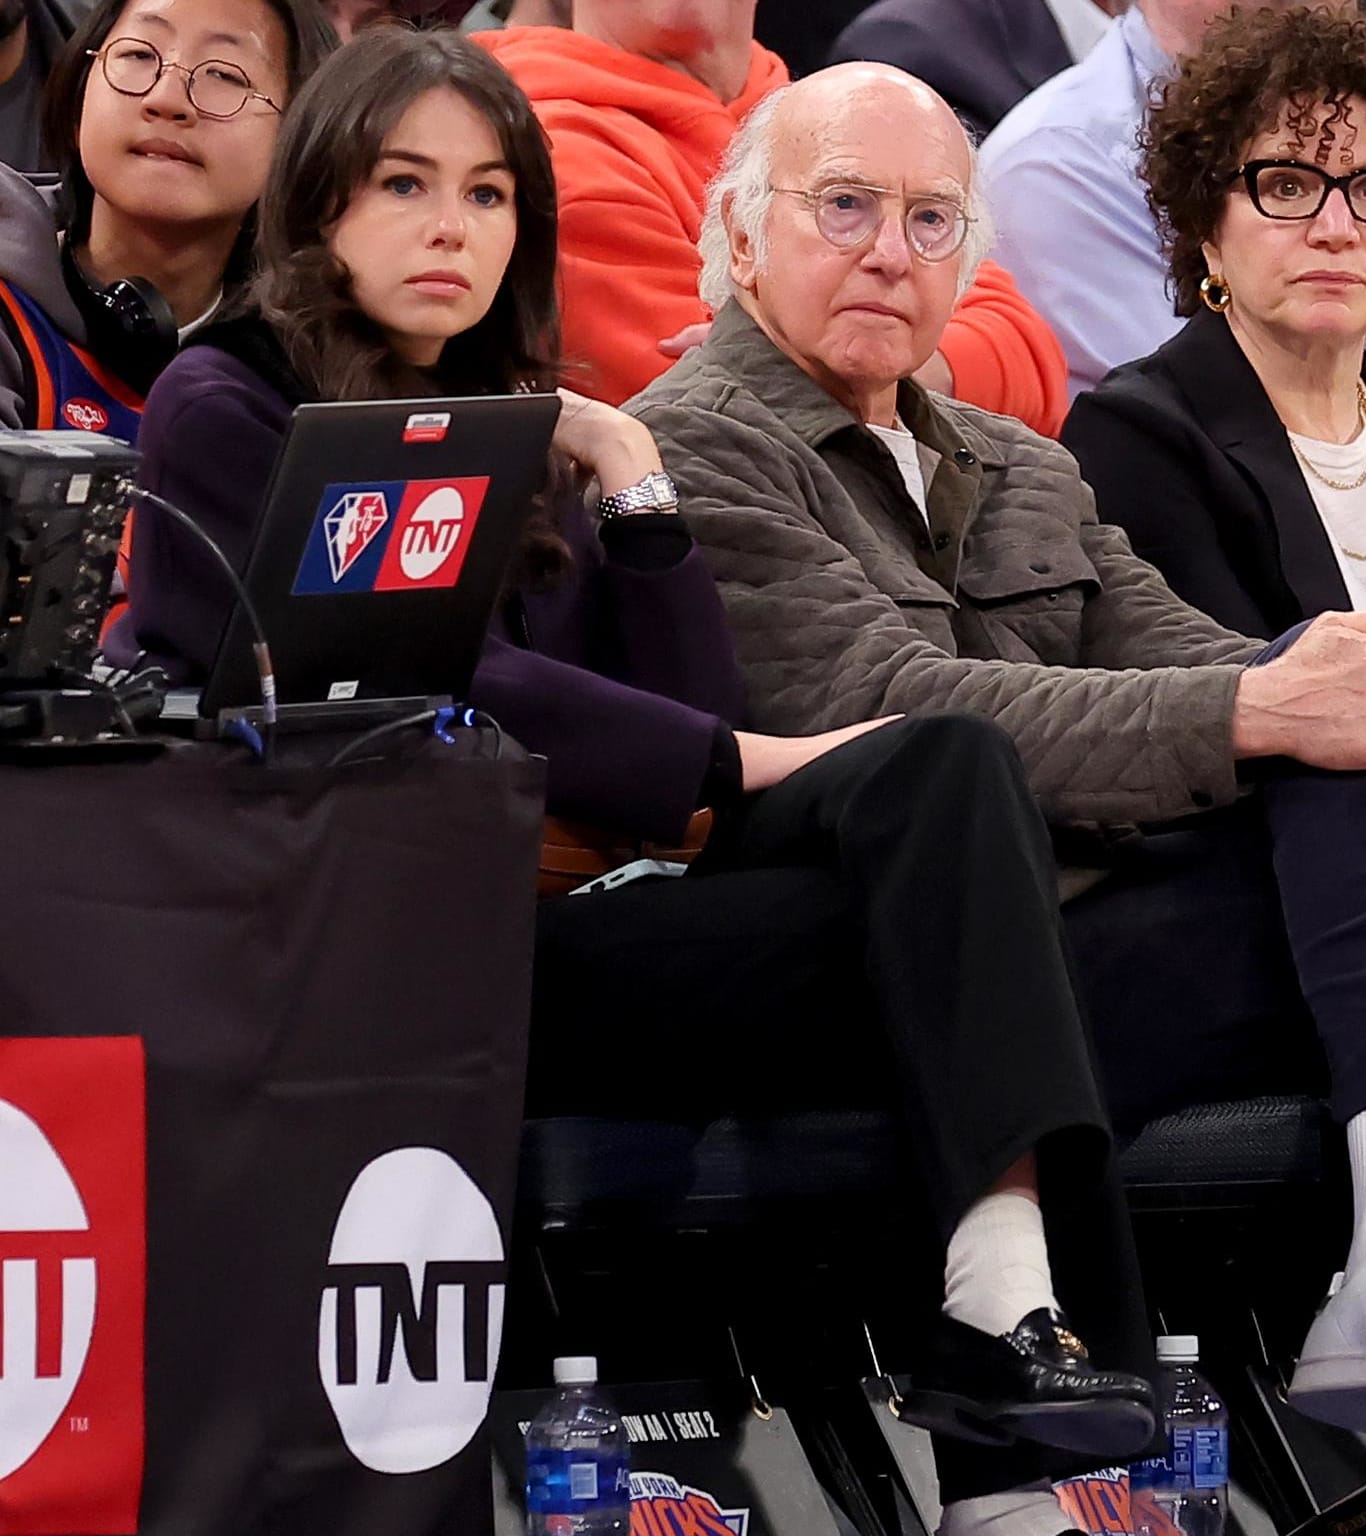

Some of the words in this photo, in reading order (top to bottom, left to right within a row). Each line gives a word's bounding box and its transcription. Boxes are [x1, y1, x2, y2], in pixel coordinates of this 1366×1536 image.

[322, 1260, 506, 1386] TNT
[70, 1417, 88, 1432] TM
[621, 1415, 649, 1442] OW
[643, 1414, 668, 1441] AA
[673, 1412, 709, 1439] SEAT
[702, 1411, 720, 1437] 2
[641, 1476, 681, 1498] YORK
